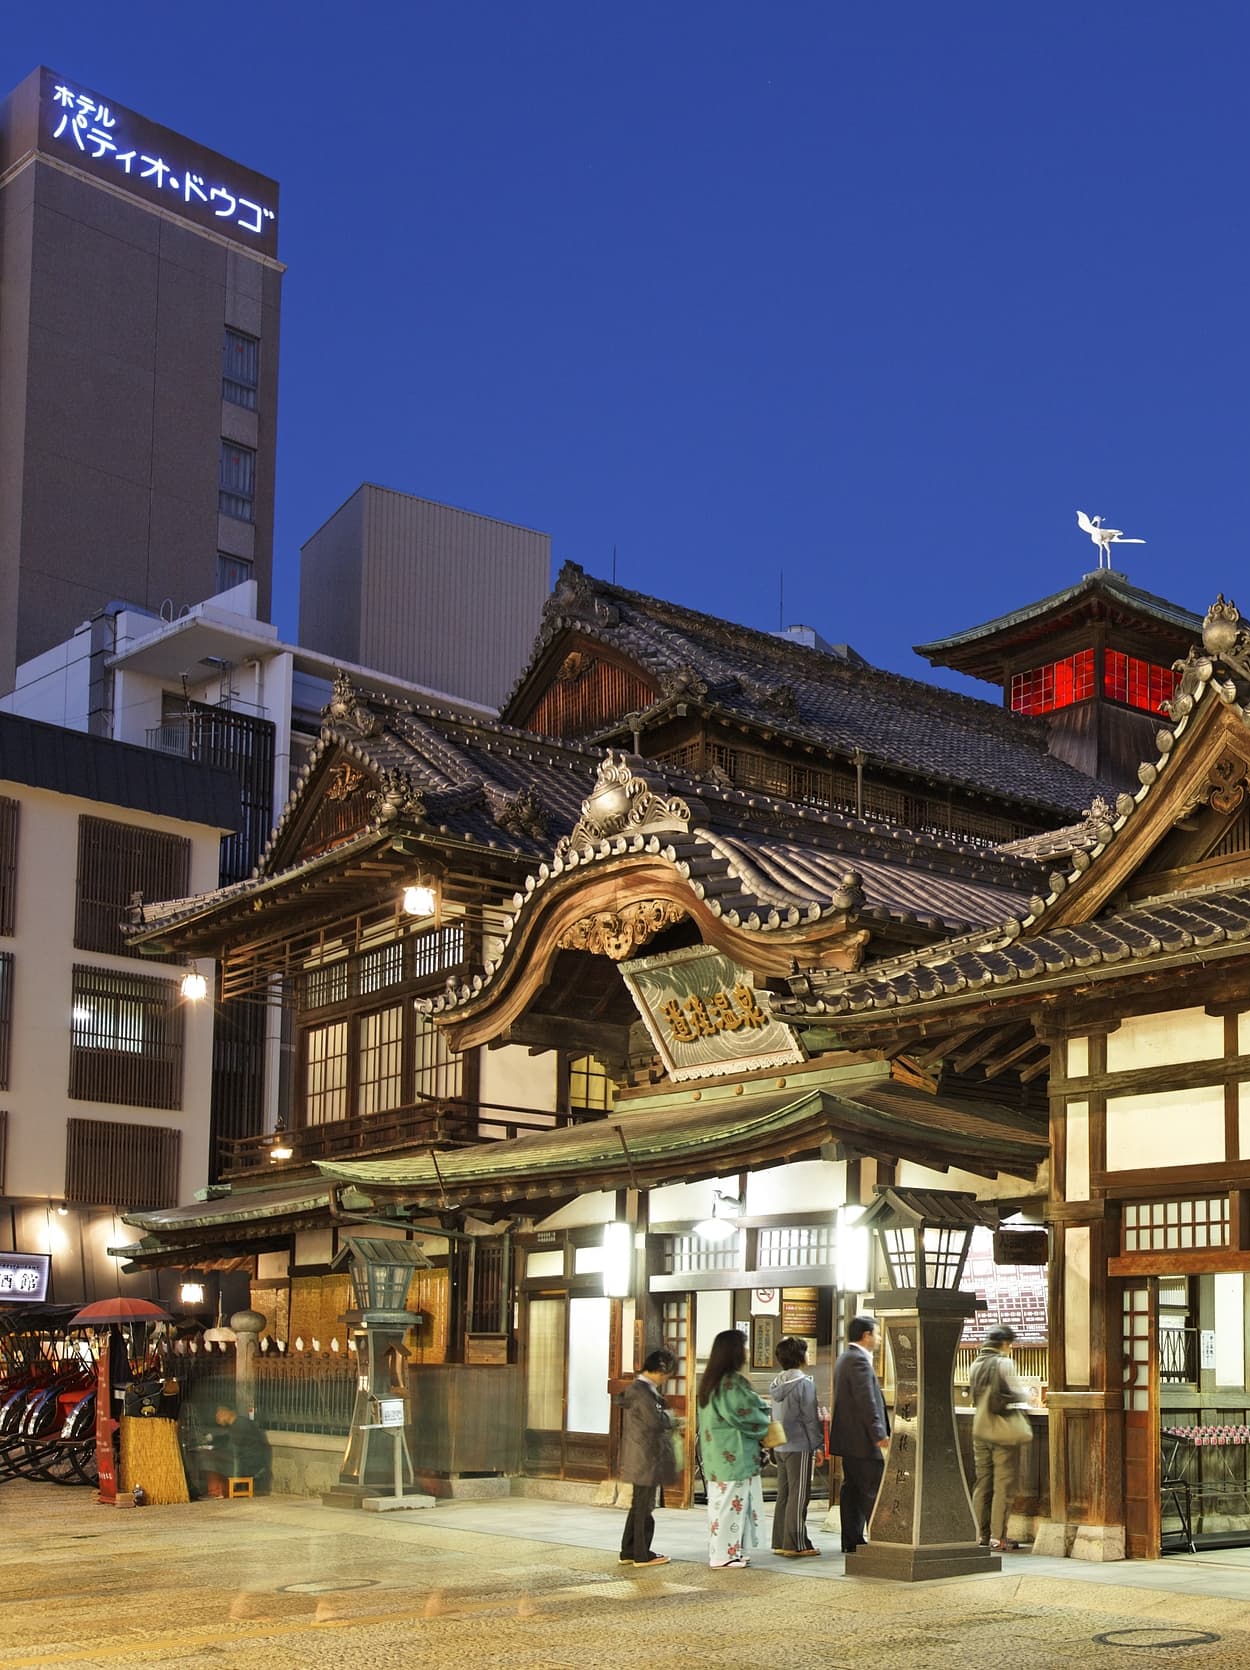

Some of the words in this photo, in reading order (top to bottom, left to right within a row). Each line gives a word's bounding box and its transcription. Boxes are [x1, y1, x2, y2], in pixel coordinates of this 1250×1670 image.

[53, 85, 116, 127] ホテル
[53, 114, 275, 233] パティオ・ドウゴ
